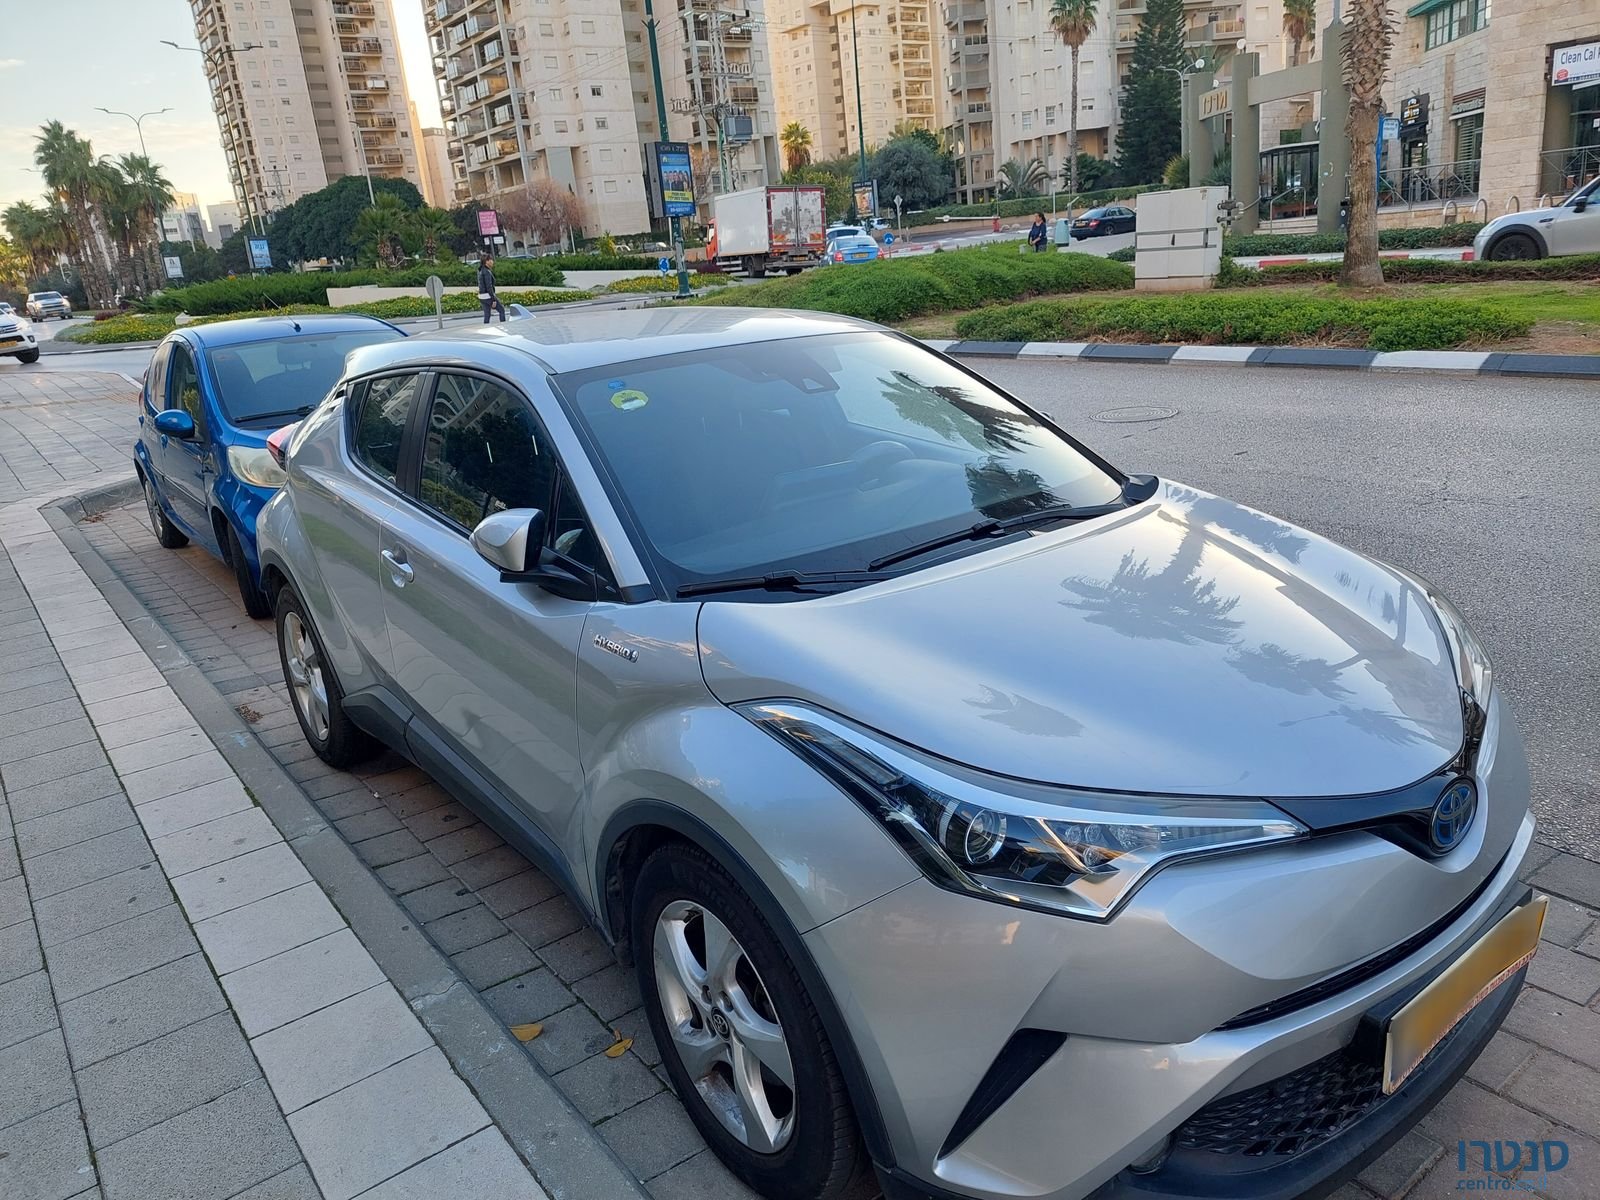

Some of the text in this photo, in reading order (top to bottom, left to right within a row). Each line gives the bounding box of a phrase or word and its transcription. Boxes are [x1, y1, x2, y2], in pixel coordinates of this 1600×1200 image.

[1560, 51, 1582, 65] Clean
[1584, 46, 1597, 61] Cal
[593, 634, 631, 659] HYBRID
